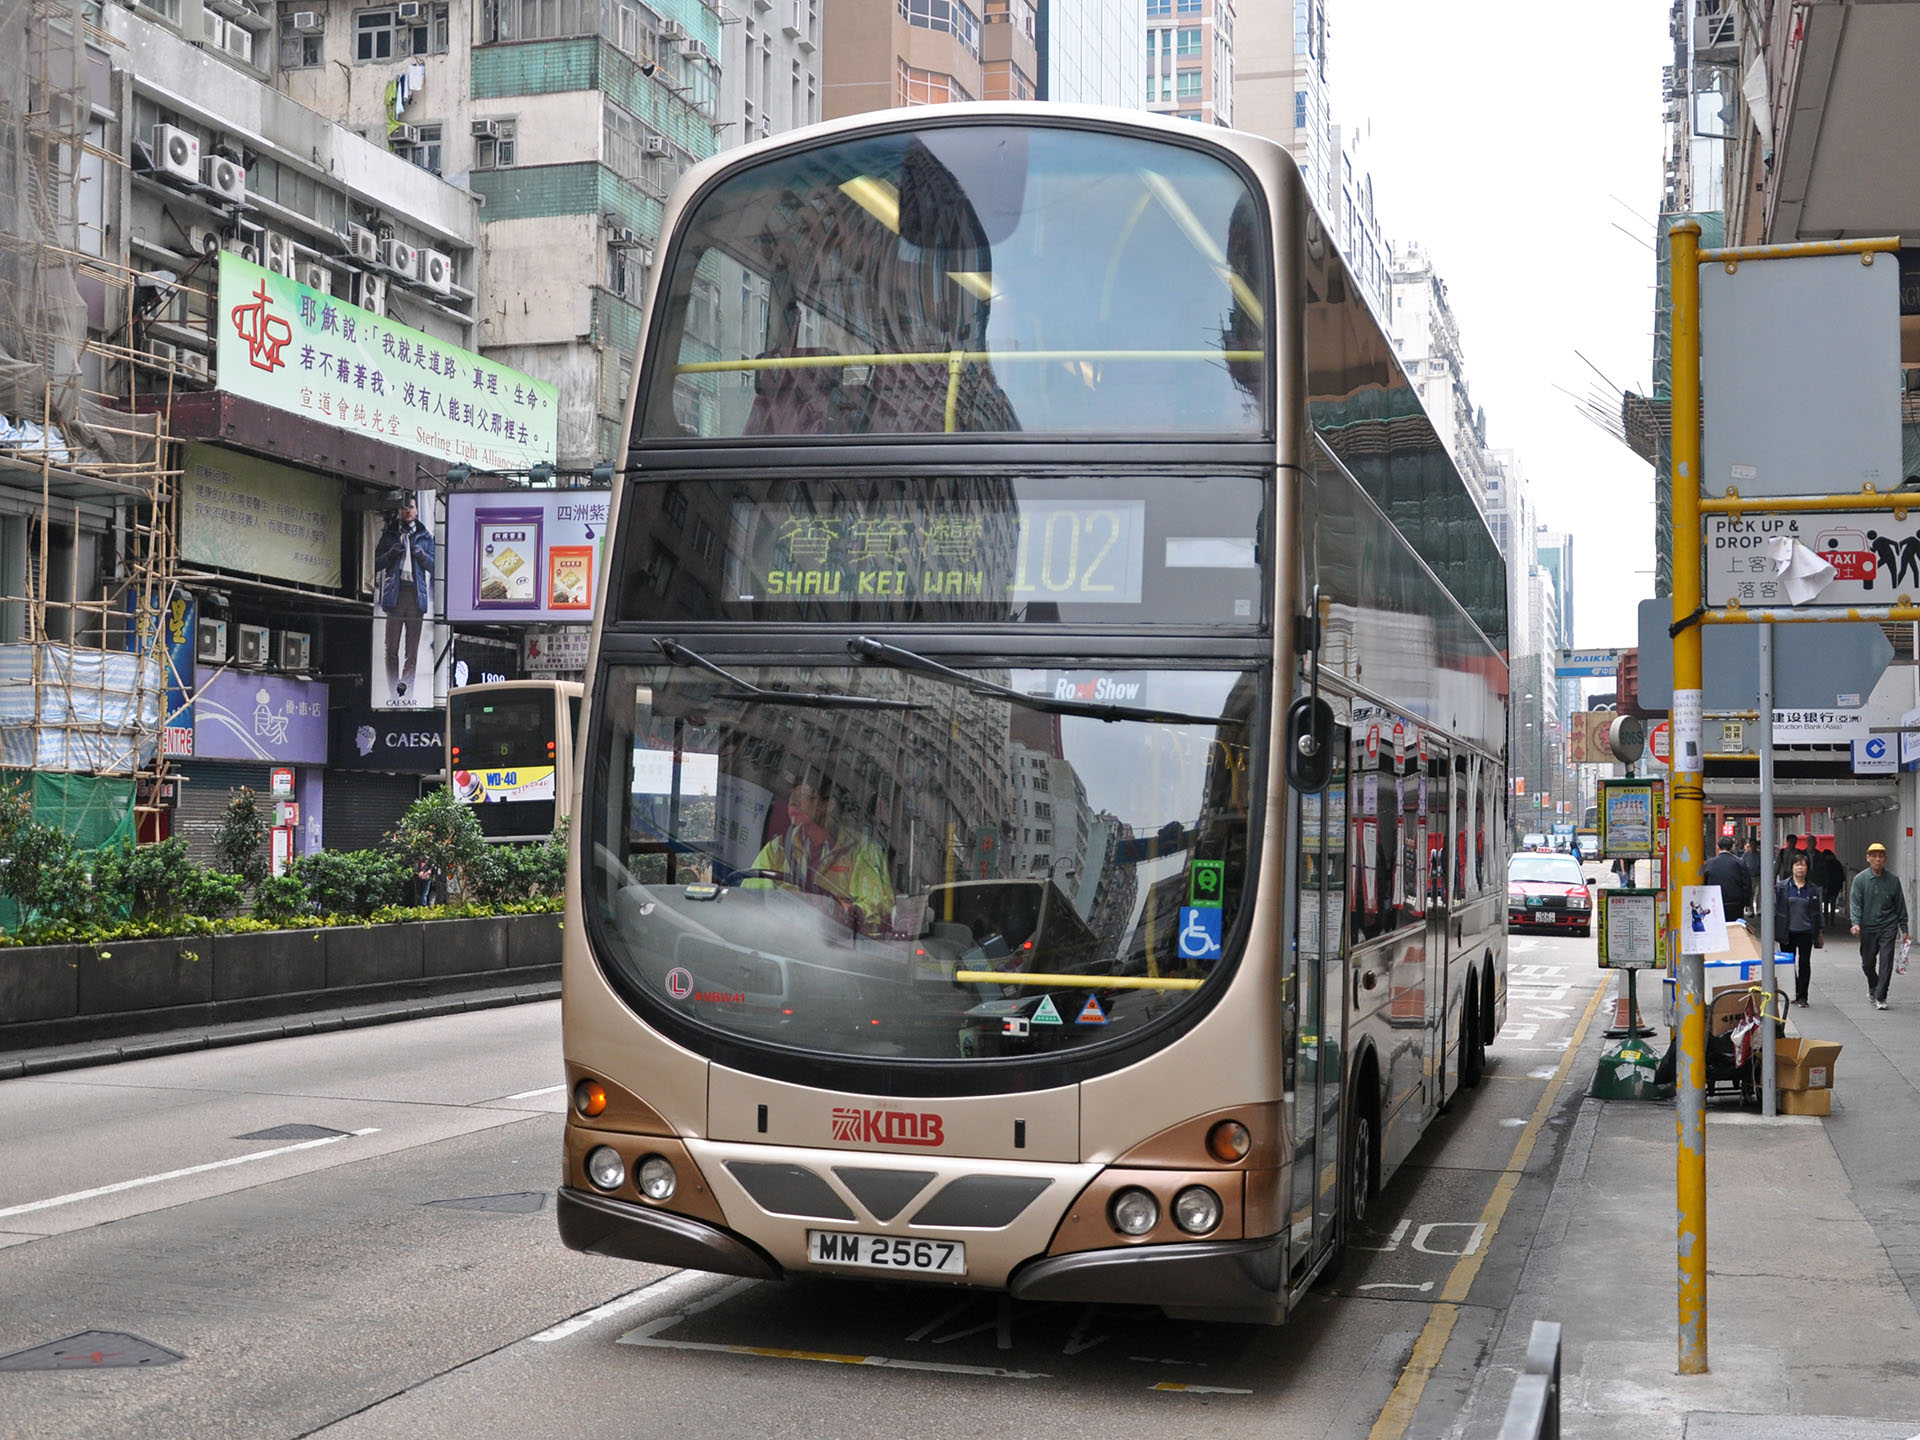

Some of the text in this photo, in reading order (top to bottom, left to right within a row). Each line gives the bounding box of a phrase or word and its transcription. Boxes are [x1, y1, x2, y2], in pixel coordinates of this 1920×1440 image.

[300, 387, 400, 437] 宣道會純光堂
[416, 426, 451, 456] Sterling
[455, 439, 478, 462] Light
[1716, 519, 1799, 533] PICK UP &
[1006, 510, 1120, 592] 102
[1715, 536, 1763, 549] DROP
[1726, 556, 1780, 574] 上客
[1826, 554, 1857, 565] TAXI
[768, 570, 983, 595] SHAU KEI WAN
[1737, 581, 1779, 599] 落客
[1573, 655, 1614, 663] DAIKIN
[1054, 676, 1140, 701] RoadShow
[386, 699, 418, 707] CAESAR
[162, 727, 193, 755] ENTRE
[385, 732, 446, 748] CAESA
[1621, 731, 1644, 745] 606S
[487, 771, 517, 787] WD-40
[819, 1234, 955, 1270] MM 2567
